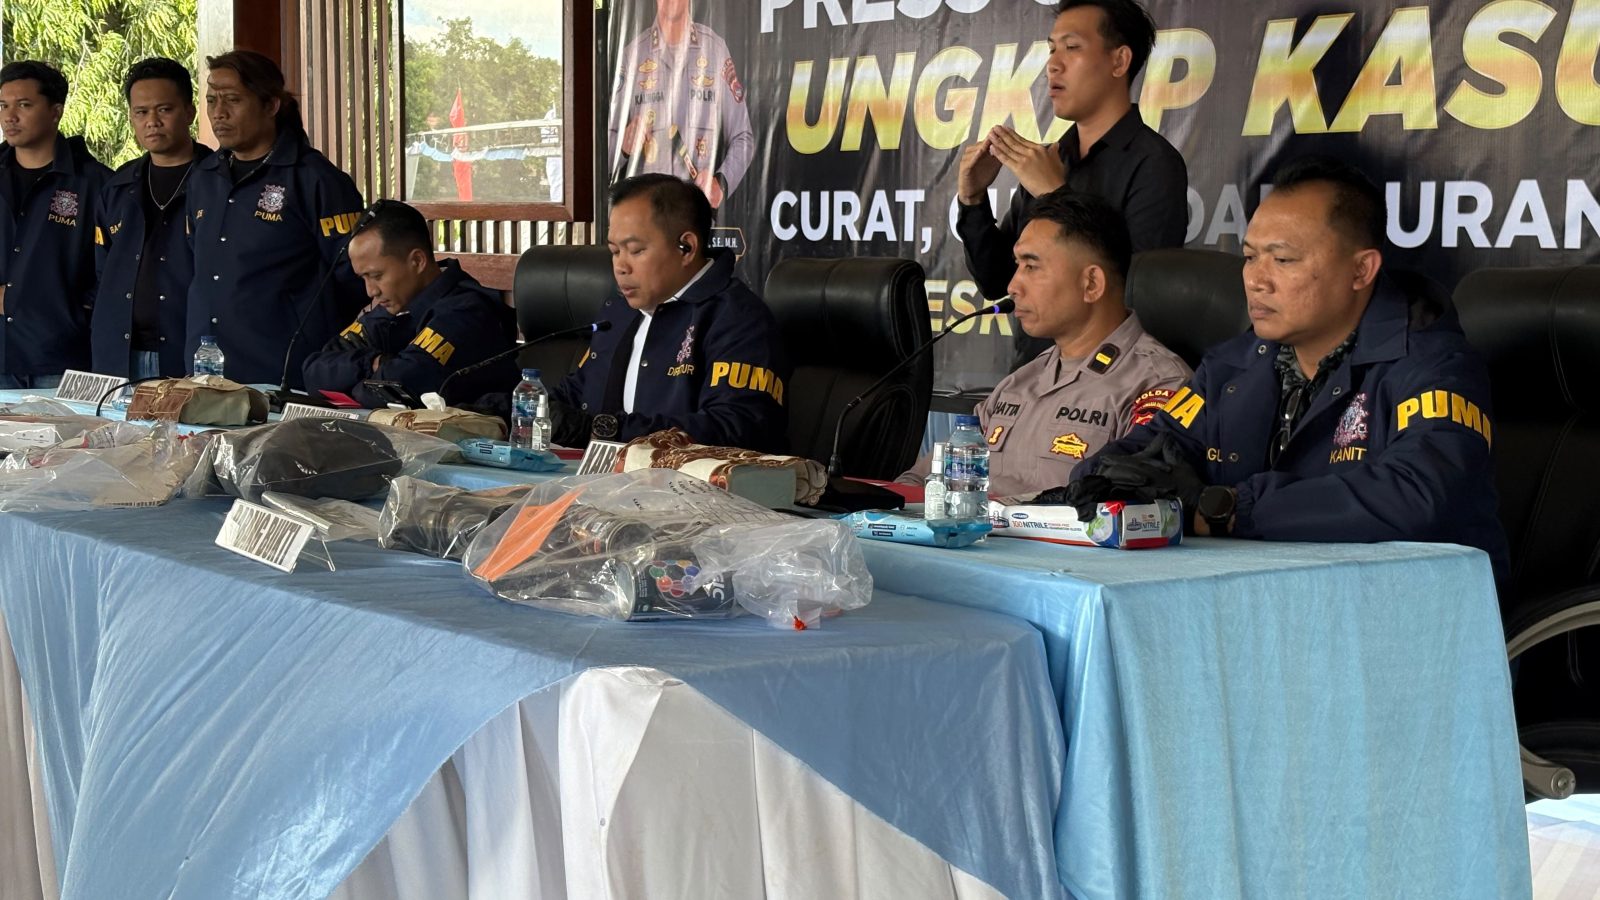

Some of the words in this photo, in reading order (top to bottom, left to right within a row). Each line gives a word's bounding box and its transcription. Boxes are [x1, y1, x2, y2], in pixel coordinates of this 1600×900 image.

[785, 28, 1217, 154] UNGKP
[48, 213, 77, 227] PUMA
[254, 210, 283, 222] PUMA
[770, 189, 932, 254] CURAT,
[710, 361, 784, 406] PUMA
[1055, 406, 1109, 427] POLRI
[1329, 446, 1367, 464] KANIT
[1023, 521, 1048, 529] NITRILE
